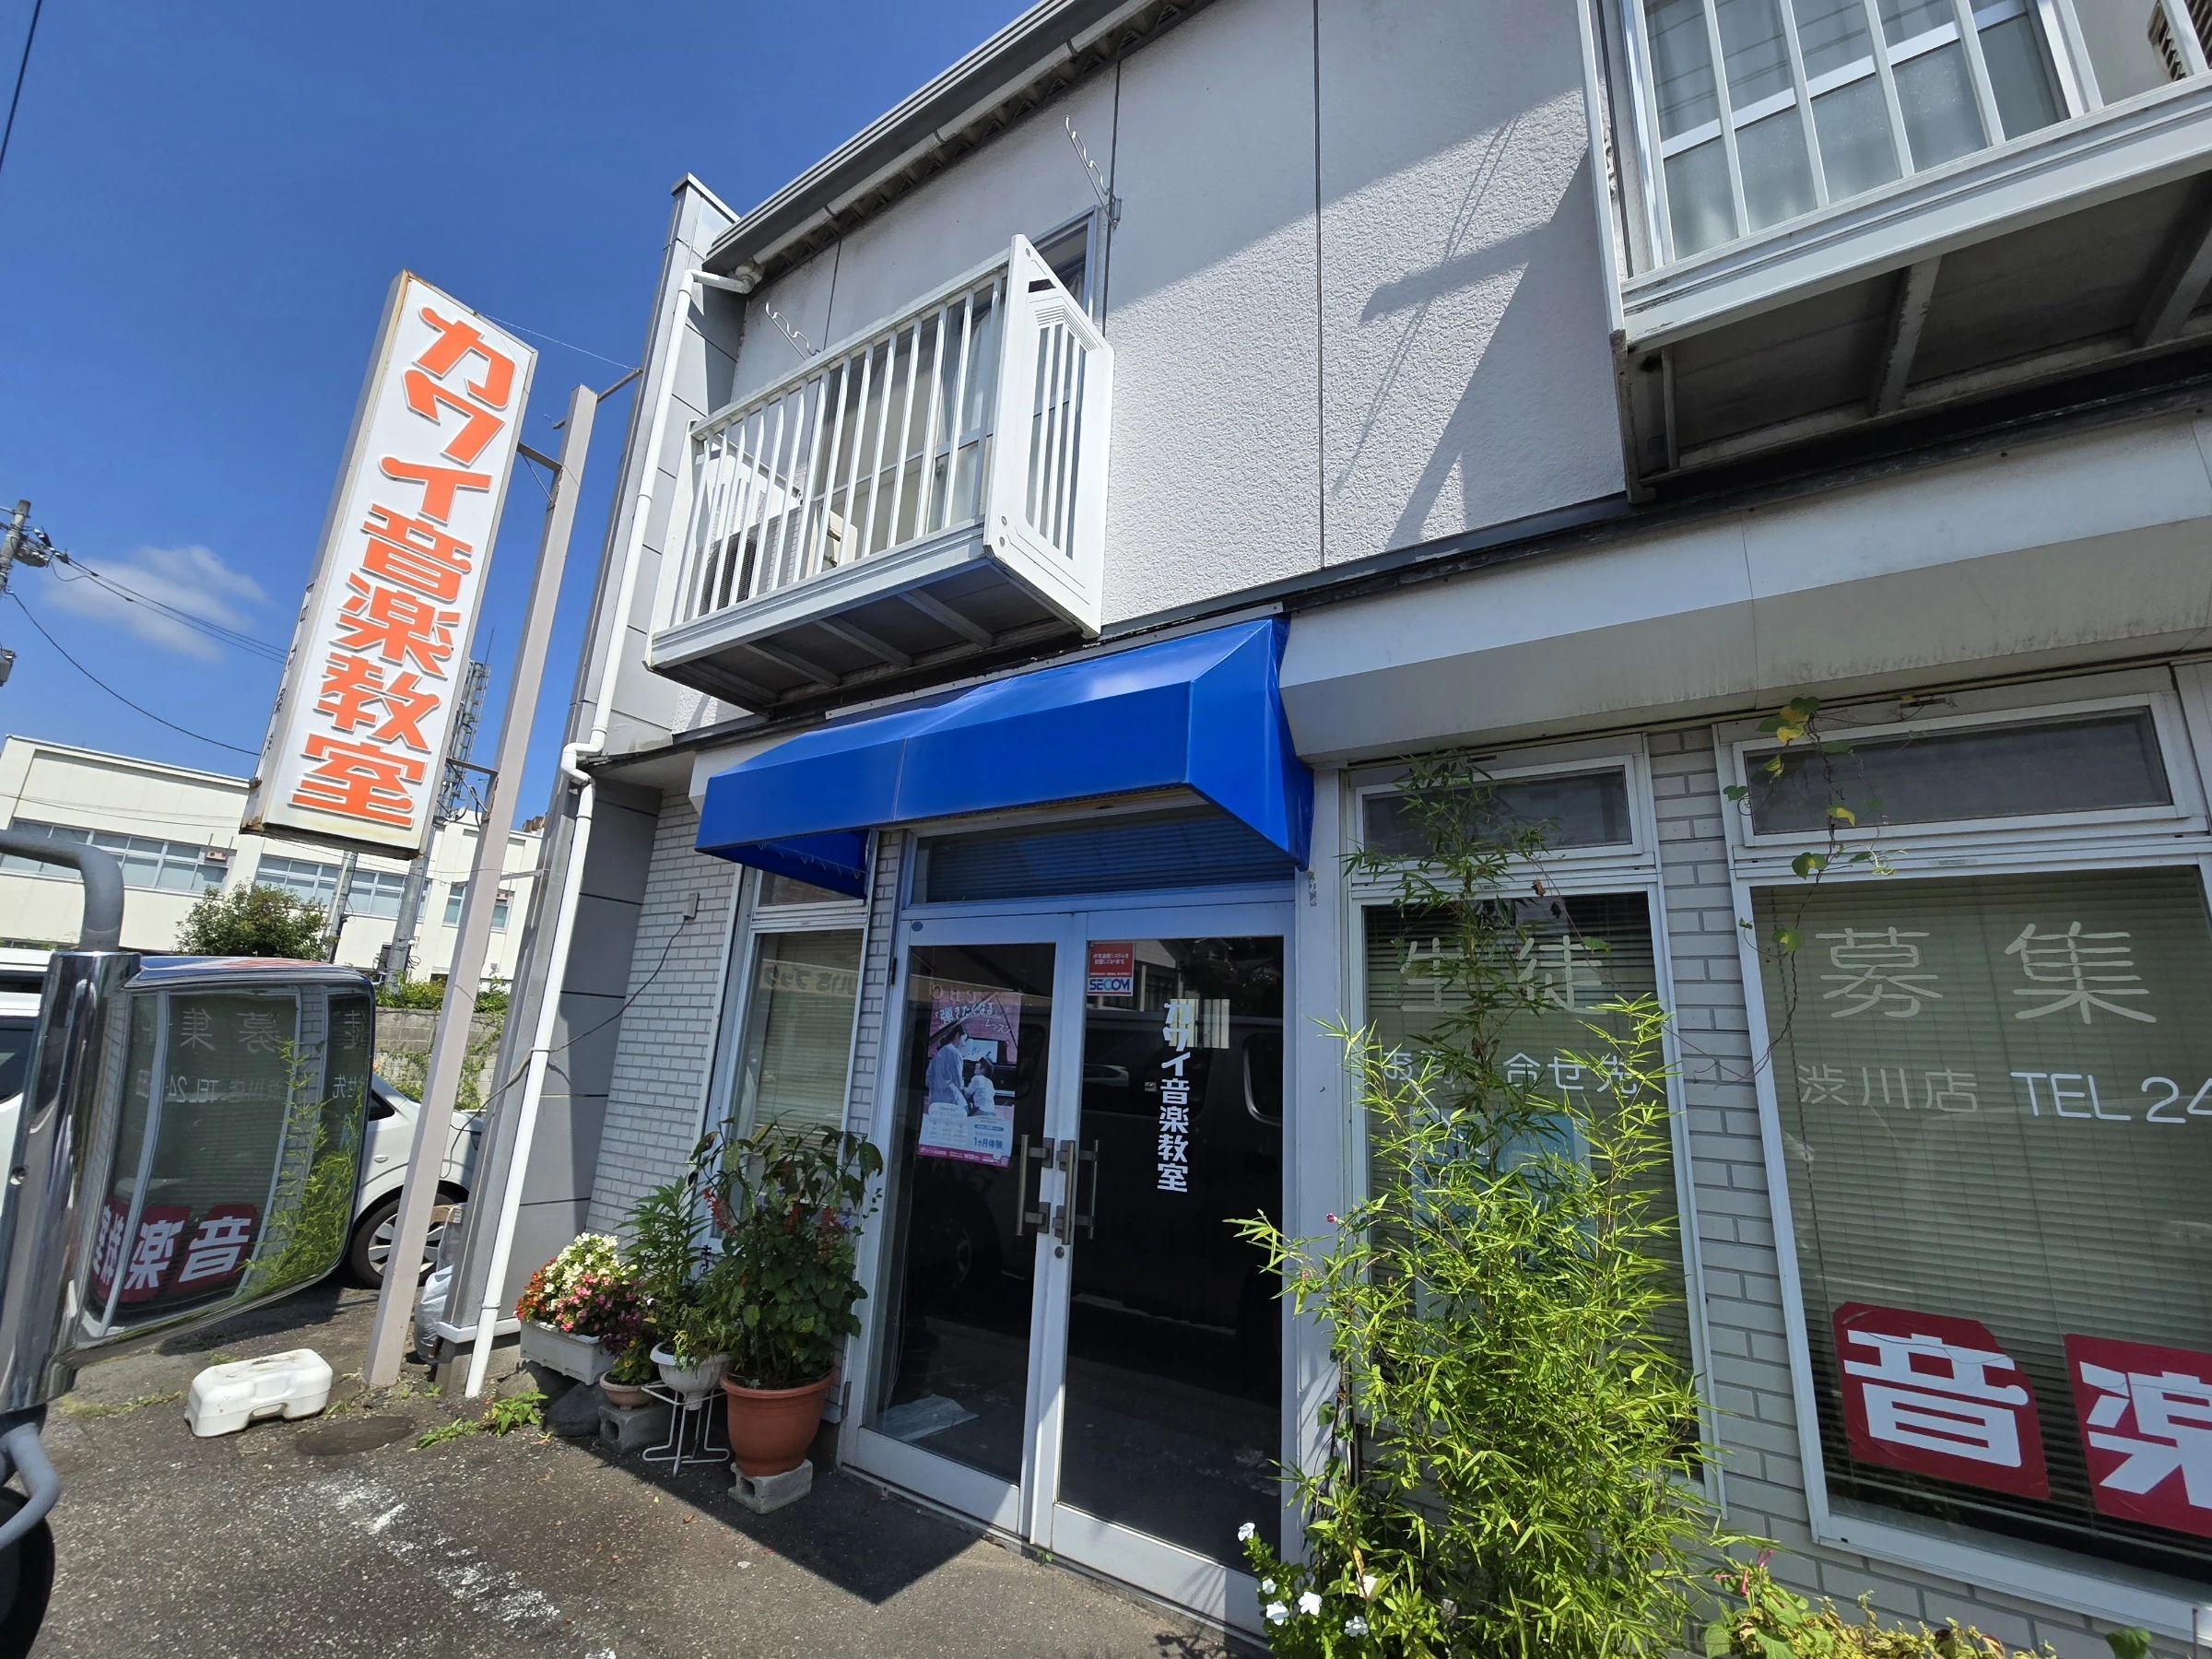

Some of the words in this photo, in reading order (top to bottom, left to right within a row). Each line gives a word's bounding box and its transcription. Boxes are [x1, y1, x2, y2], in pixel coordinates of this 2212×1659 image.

[288, 304, 516, 830] カワイ音楽教室
[1089, 978, 1130, 991] SECOM
[1399, 934, 1608, 1015] 生徒
[1815, 921, 2157, 1024] 募集
[1157, 1002, 1193, 1193] カワイ音楽教室
[1798, 1064, 1977, 1113] 渋川店
[2010, 1071, 2132, 1121] TEL
